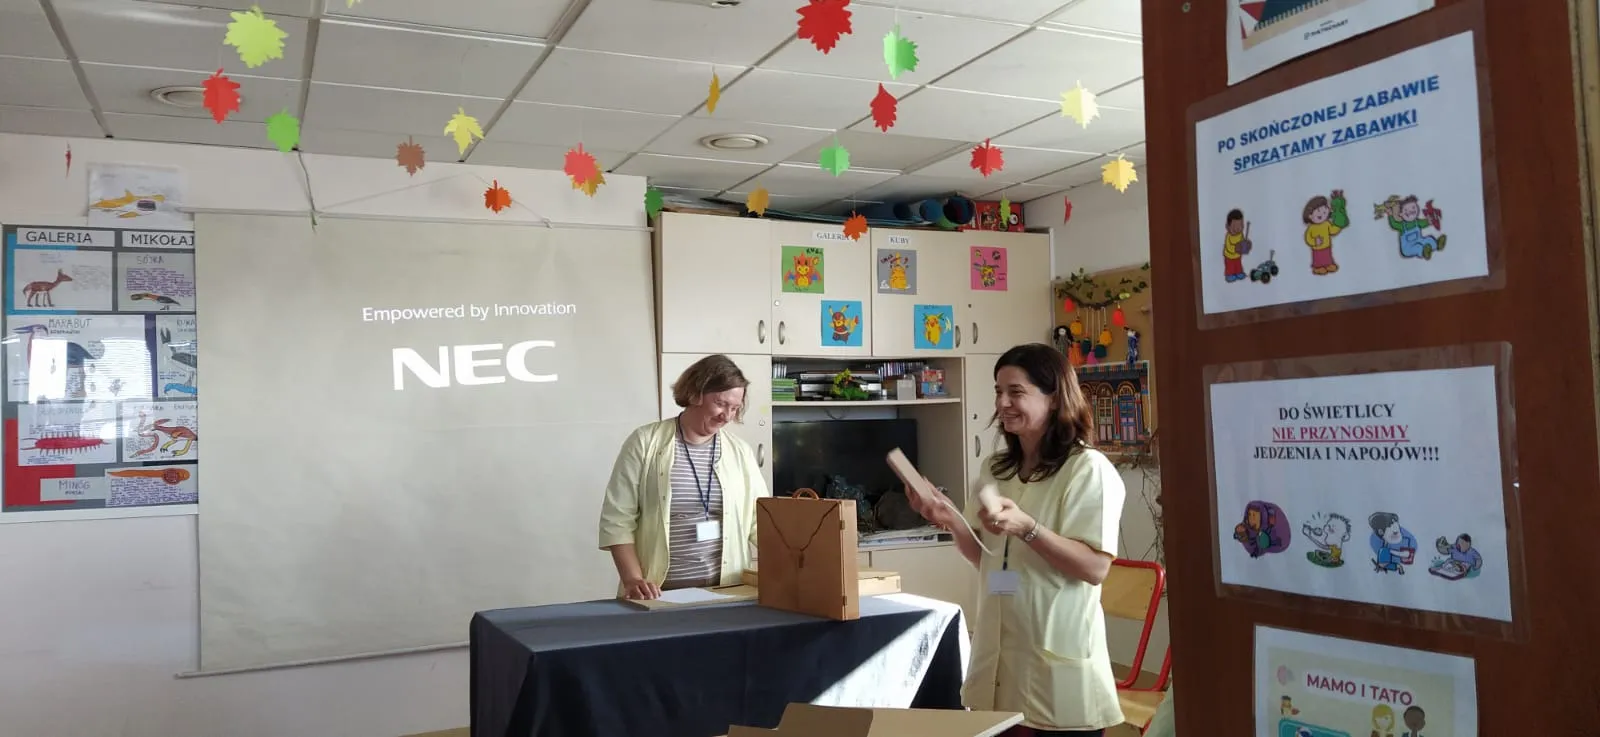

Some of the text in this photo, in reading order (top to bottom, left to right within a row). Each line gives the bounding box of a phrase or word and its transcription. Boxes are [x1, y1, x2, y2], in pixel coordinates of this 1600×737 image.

[1217, 75, 1440, 153] PO SKOŃCZONEJ ZABAWIE
[1233, 108, 1417, 172] SPRZĄTAMY ZABAWKI
[26, 231, 194, 246] GALERIA MIKOŁAJ
[362, 301, 576, 323] Empowered by Innovation
[392, 340, 558, 391] NEC
[1279, 402, 1396, 420] DO ŚWIETLICY
[1272, 424, 1408, 441] NIE PRZYNOSIMY
[1253, 442, 1440, 461] JEDZENIA I NAPOJÓW!!!
[1307, 673, 1413, 706] MAMO I TATO
